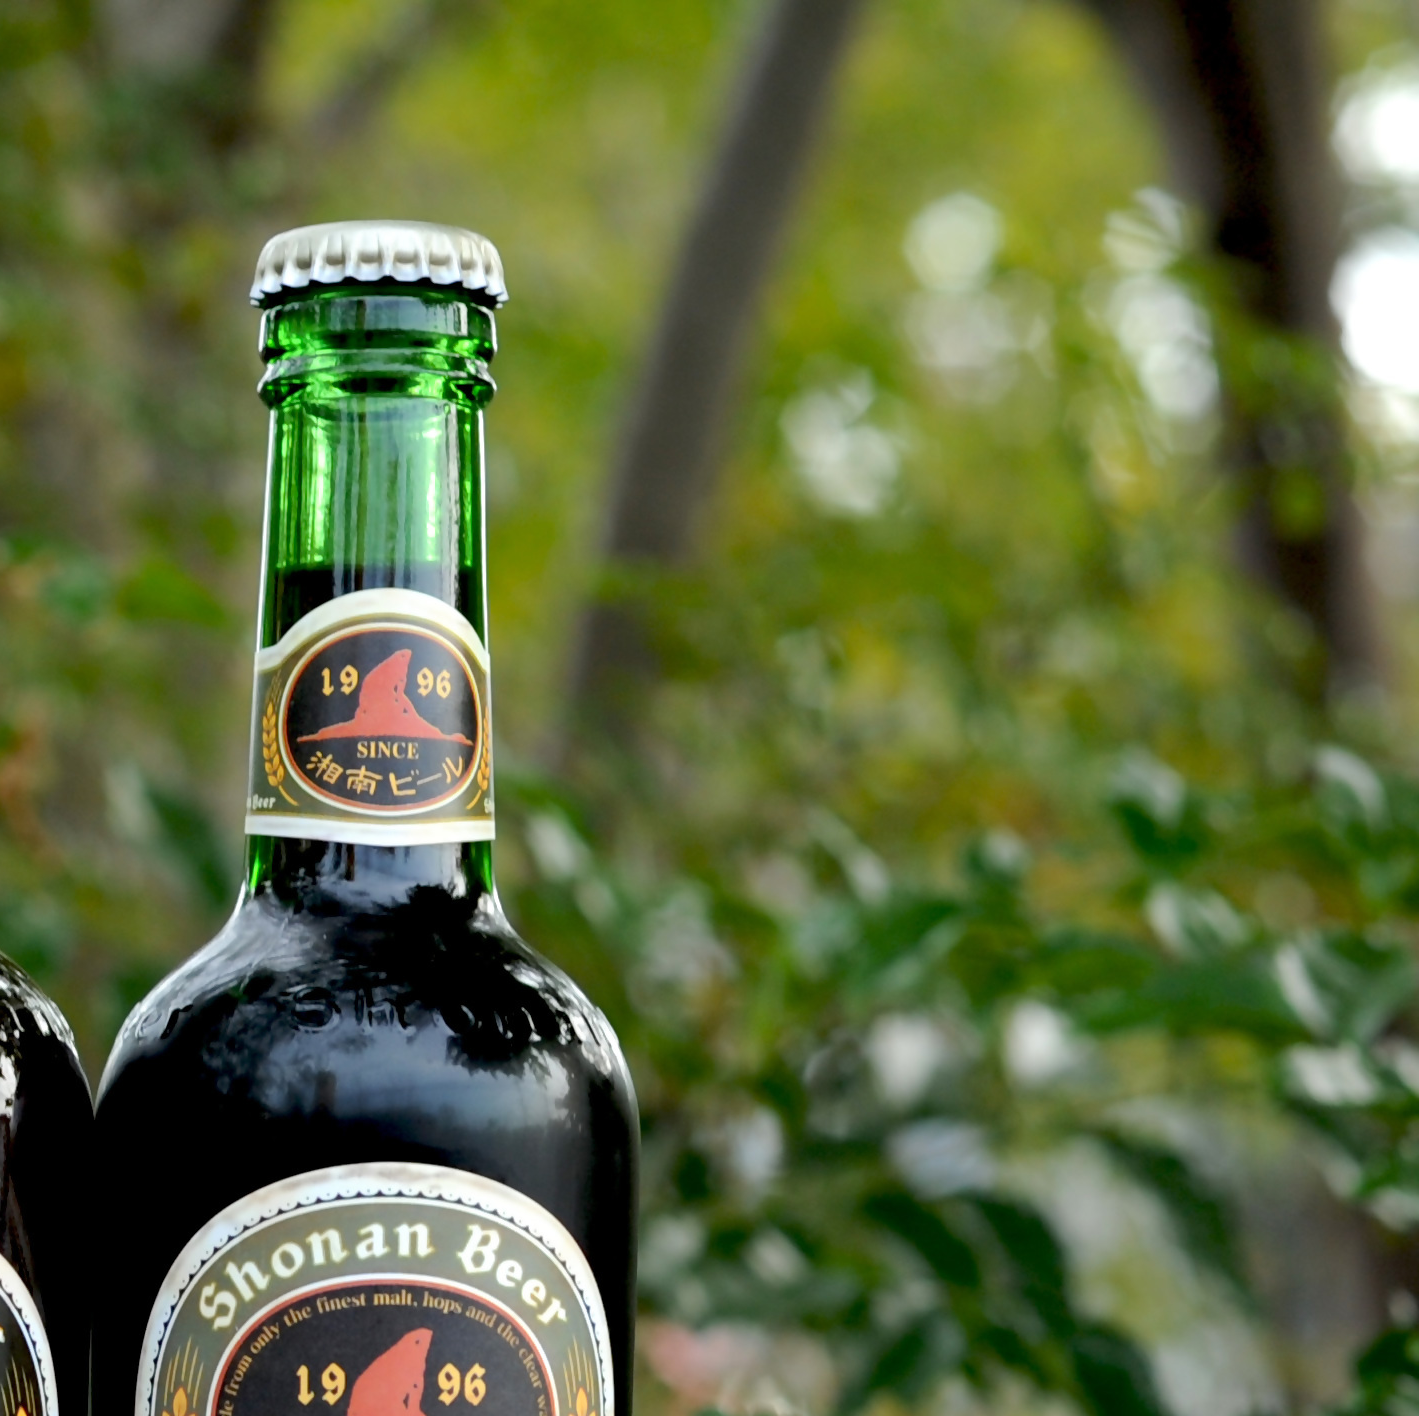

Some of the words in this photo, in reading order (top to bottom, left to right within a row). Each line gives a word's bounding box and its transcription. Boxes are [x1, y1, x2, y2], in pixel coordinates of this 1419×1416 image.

[322, 665, 358, 696] 19
[417, 667, 451, 698] 96
[357, 741, 418, 759] SINCE
[307, 751, 463, 796] 湘南ビール
[198, 1221, 435, 1331] Shonan
[457, 1223, 567, 1326] Beer
[225, 1354, 252, 1396] from
[250, 1322, 280, 1354] only
[283, 1306, 312, 1327] the
[316, 1293, 366, 1314] finest
[422, 1291, 462, 1314] hops
[466, 1306, 497, 1328] and
[497, 1323, 519, 1348] the
[519, 1348, 543, 1389] clear
[296, 1362, 347, 1406] 19
[438, 1363, 486, 1406] 96
